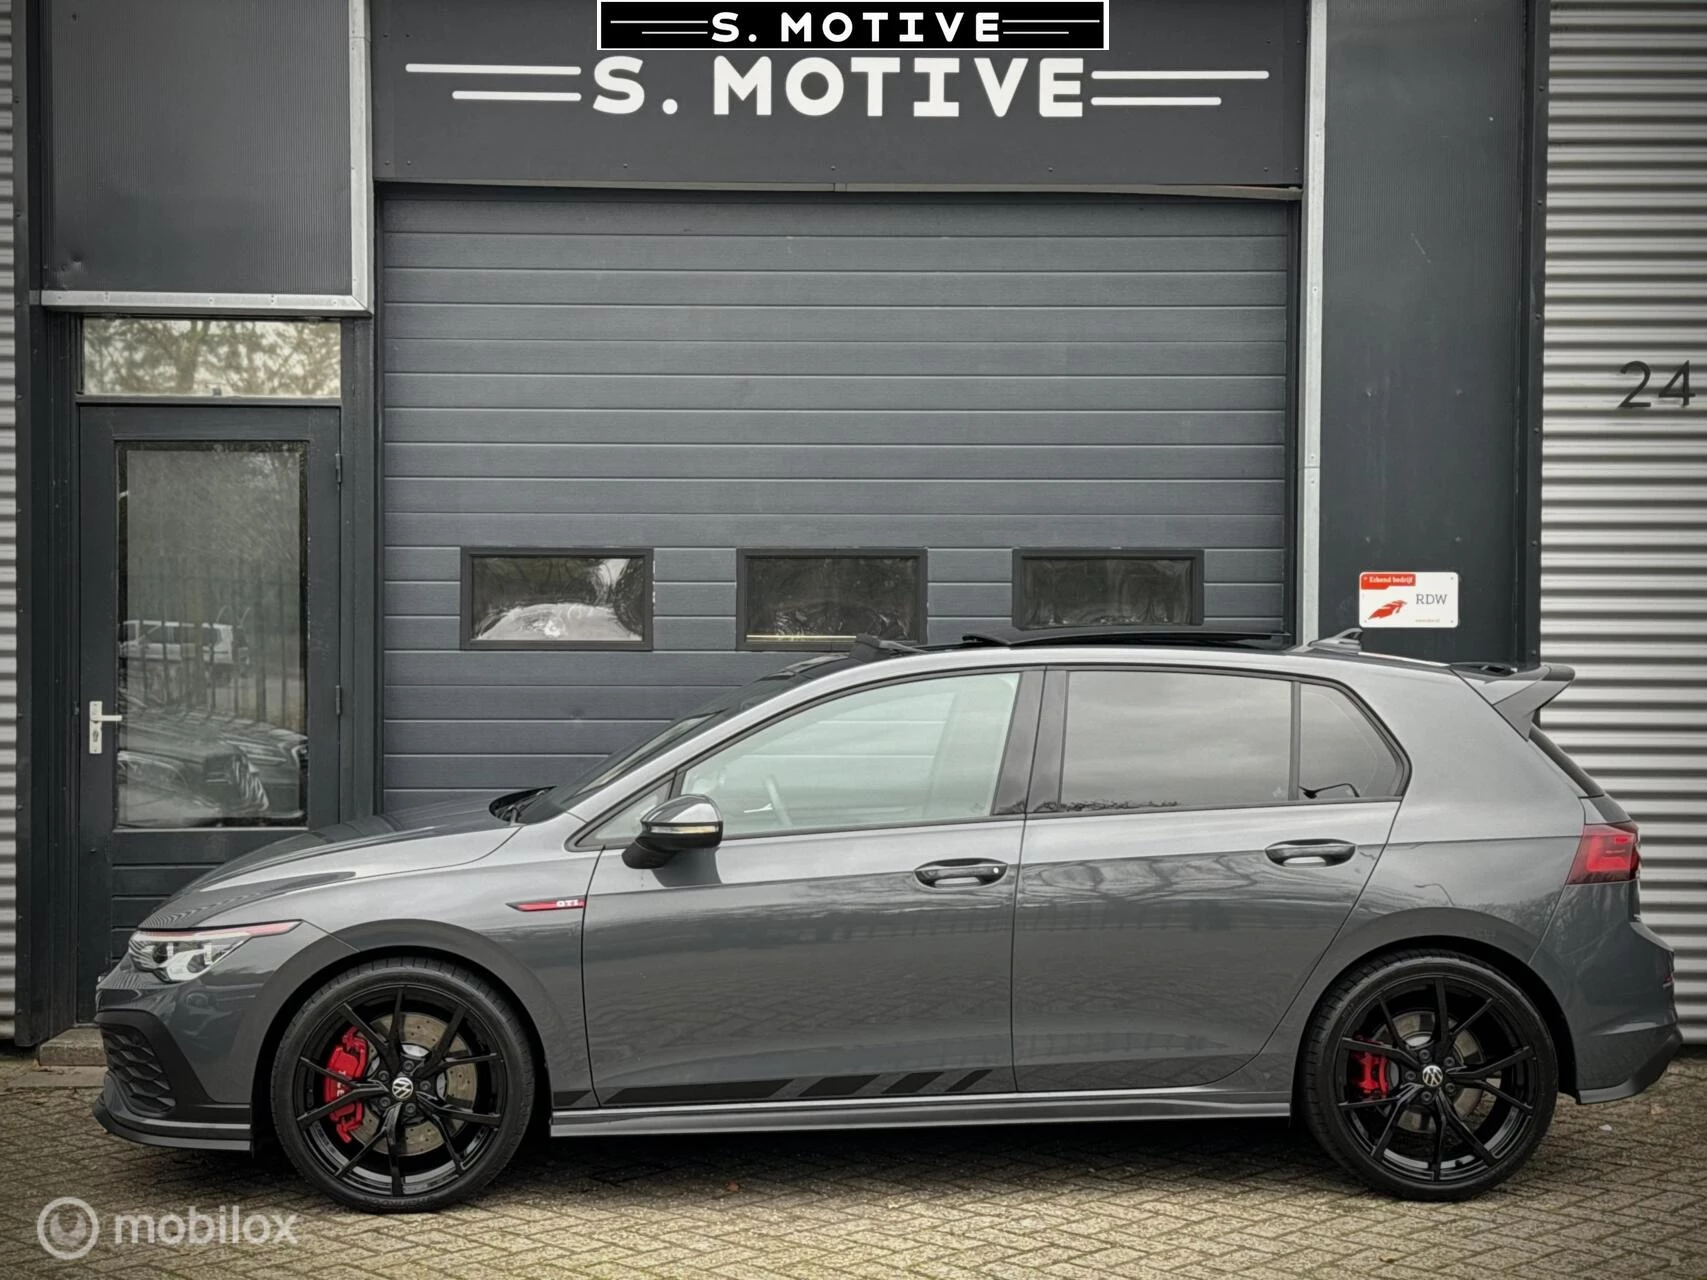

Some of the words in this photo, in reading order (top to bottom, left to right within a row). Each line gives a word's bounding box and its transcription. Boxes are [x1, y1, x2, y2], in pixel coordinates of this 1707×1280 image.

[592, 55, 678, 116] S.
[713, 55, 1085, 118] MOTIVE
[1617, 360, 1696, 408] 24
[1415, 593, 1447, 605] RDW
